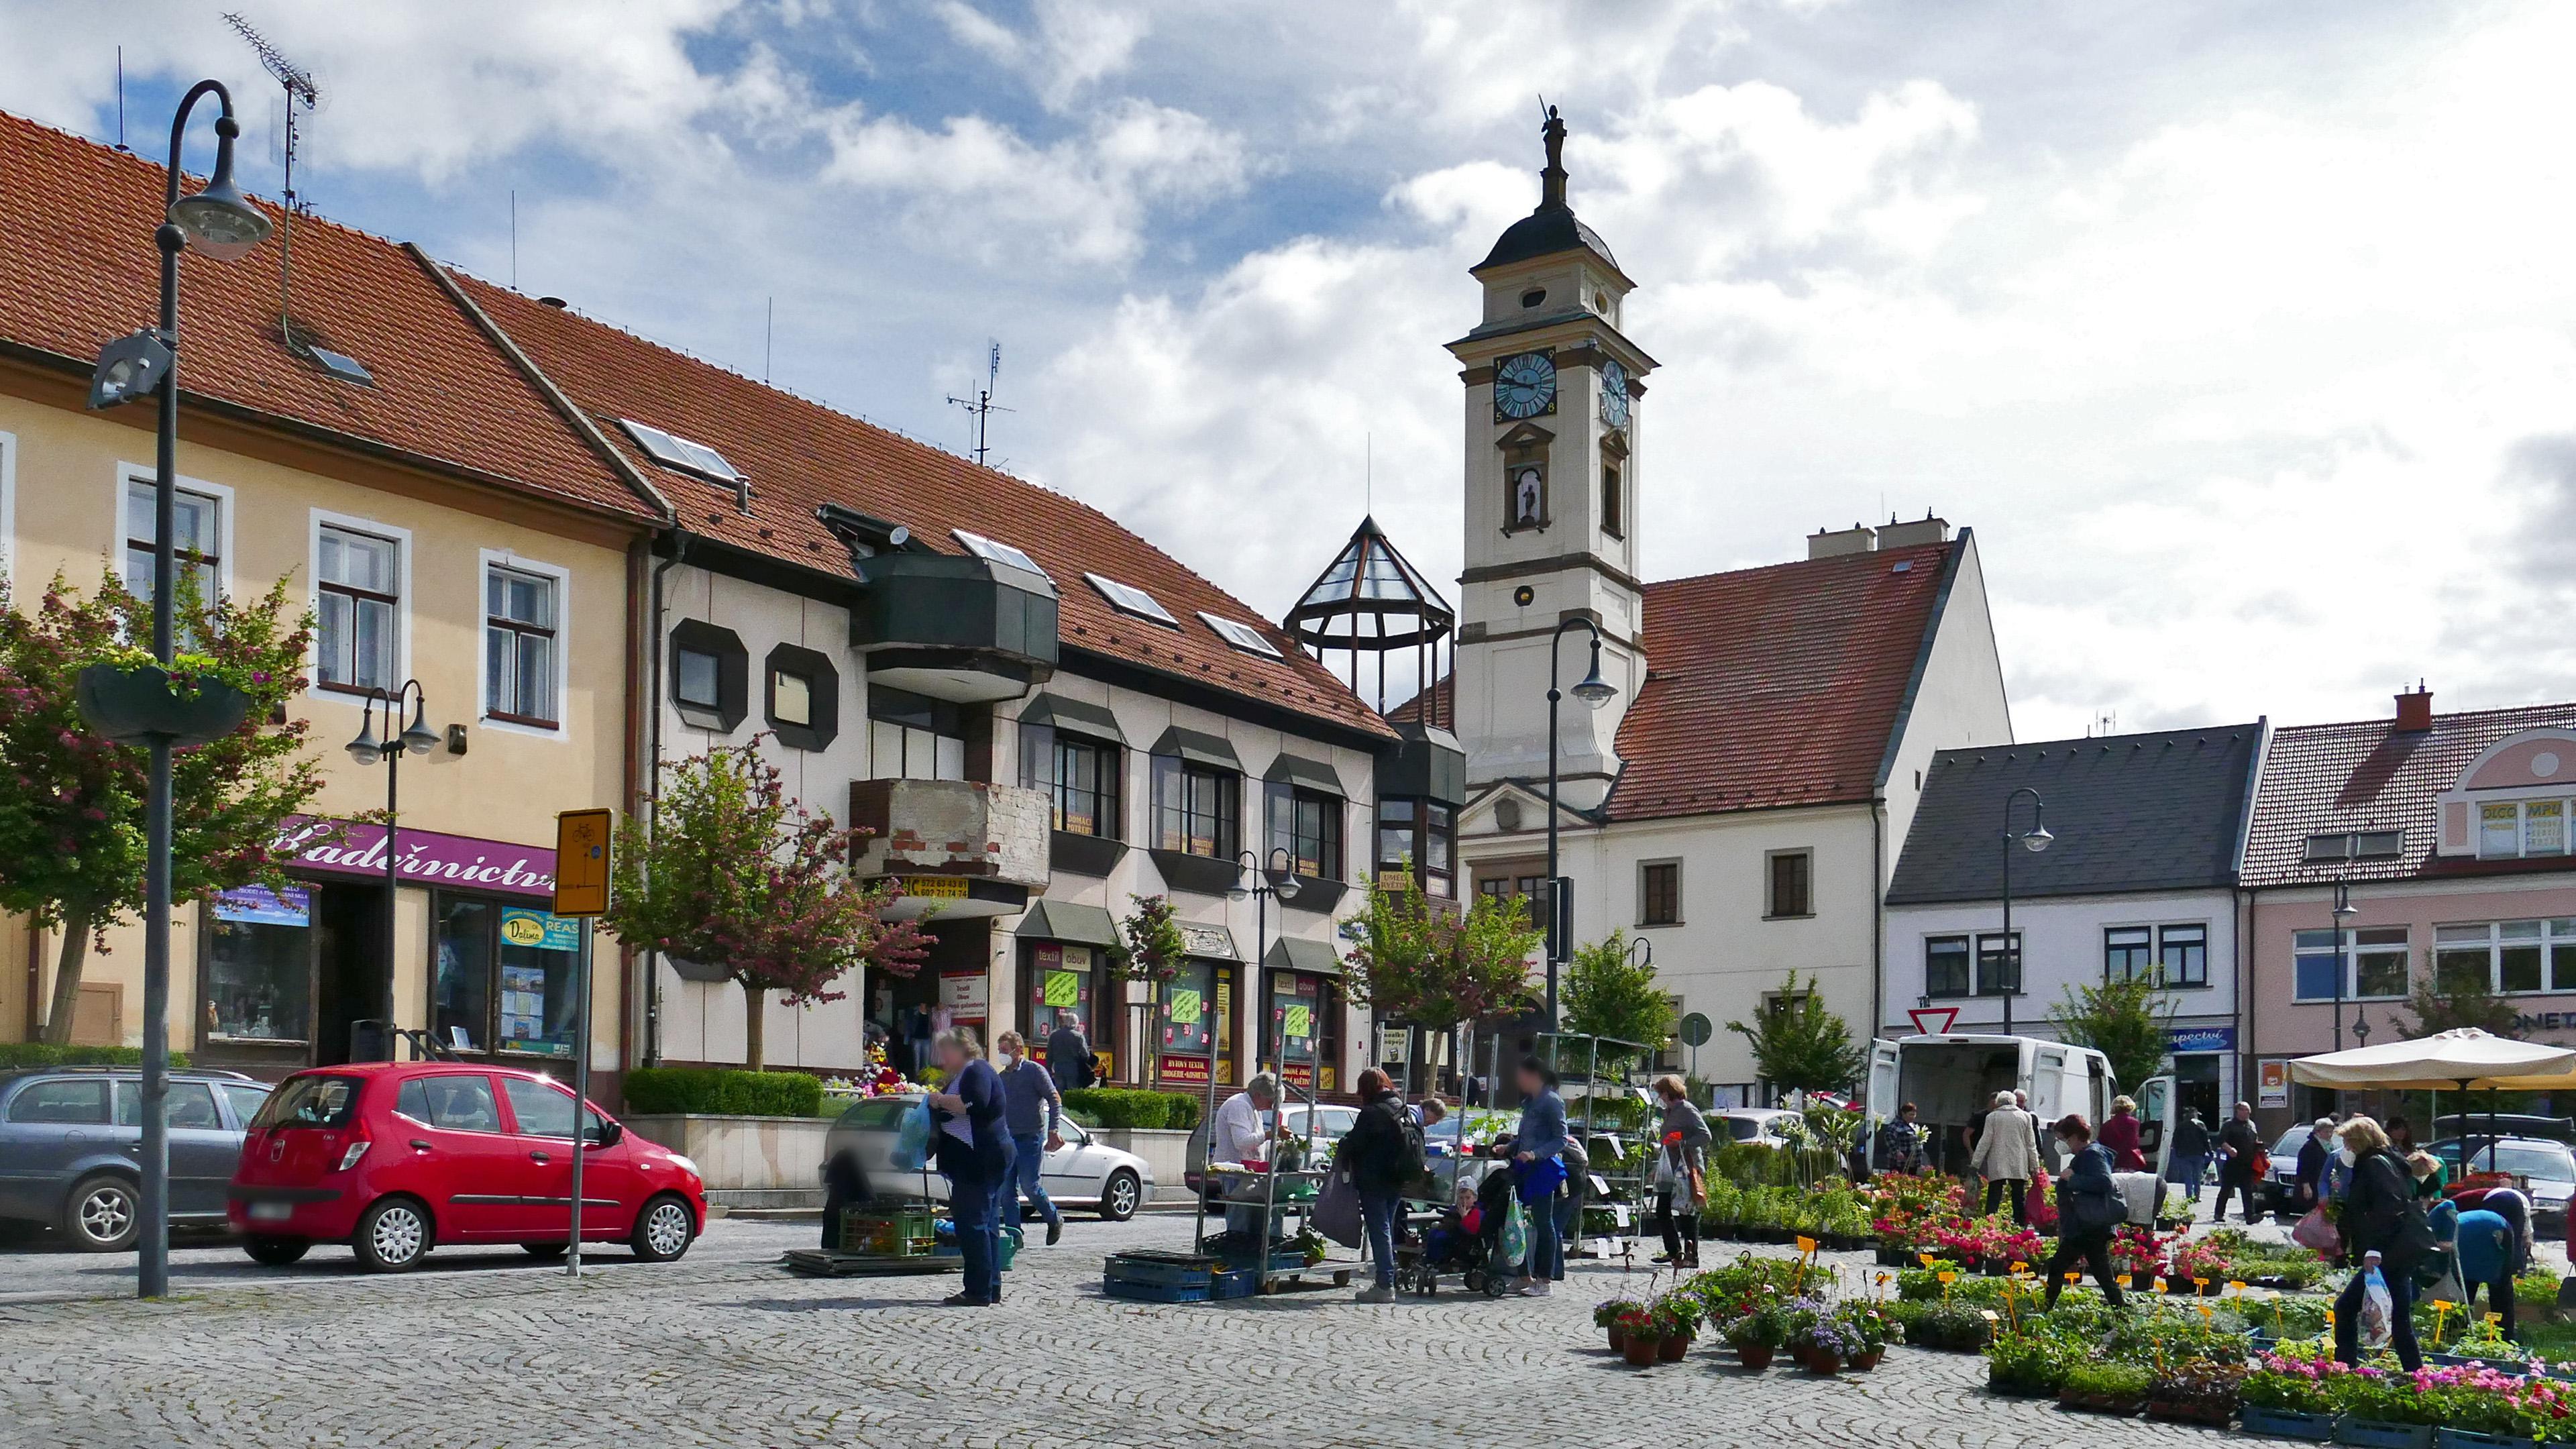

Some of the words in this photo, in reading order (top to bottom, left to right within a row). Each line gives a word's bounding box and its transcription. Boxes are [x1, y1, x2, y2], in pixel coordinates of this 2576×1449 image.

[1548, 350, 1554, 360] 9
[1548, 402, 1555, 412] 8
[1496, 412, 1503, 421] 5
[272, 823, 556, 892] Kadeřnictv
[509, 920, 540, 940] Dalima
[1038, 949, 1060, 962] textil
[1065, 953, 1087, 965] obuv
[1299, 981, 1315, 991] obuv
